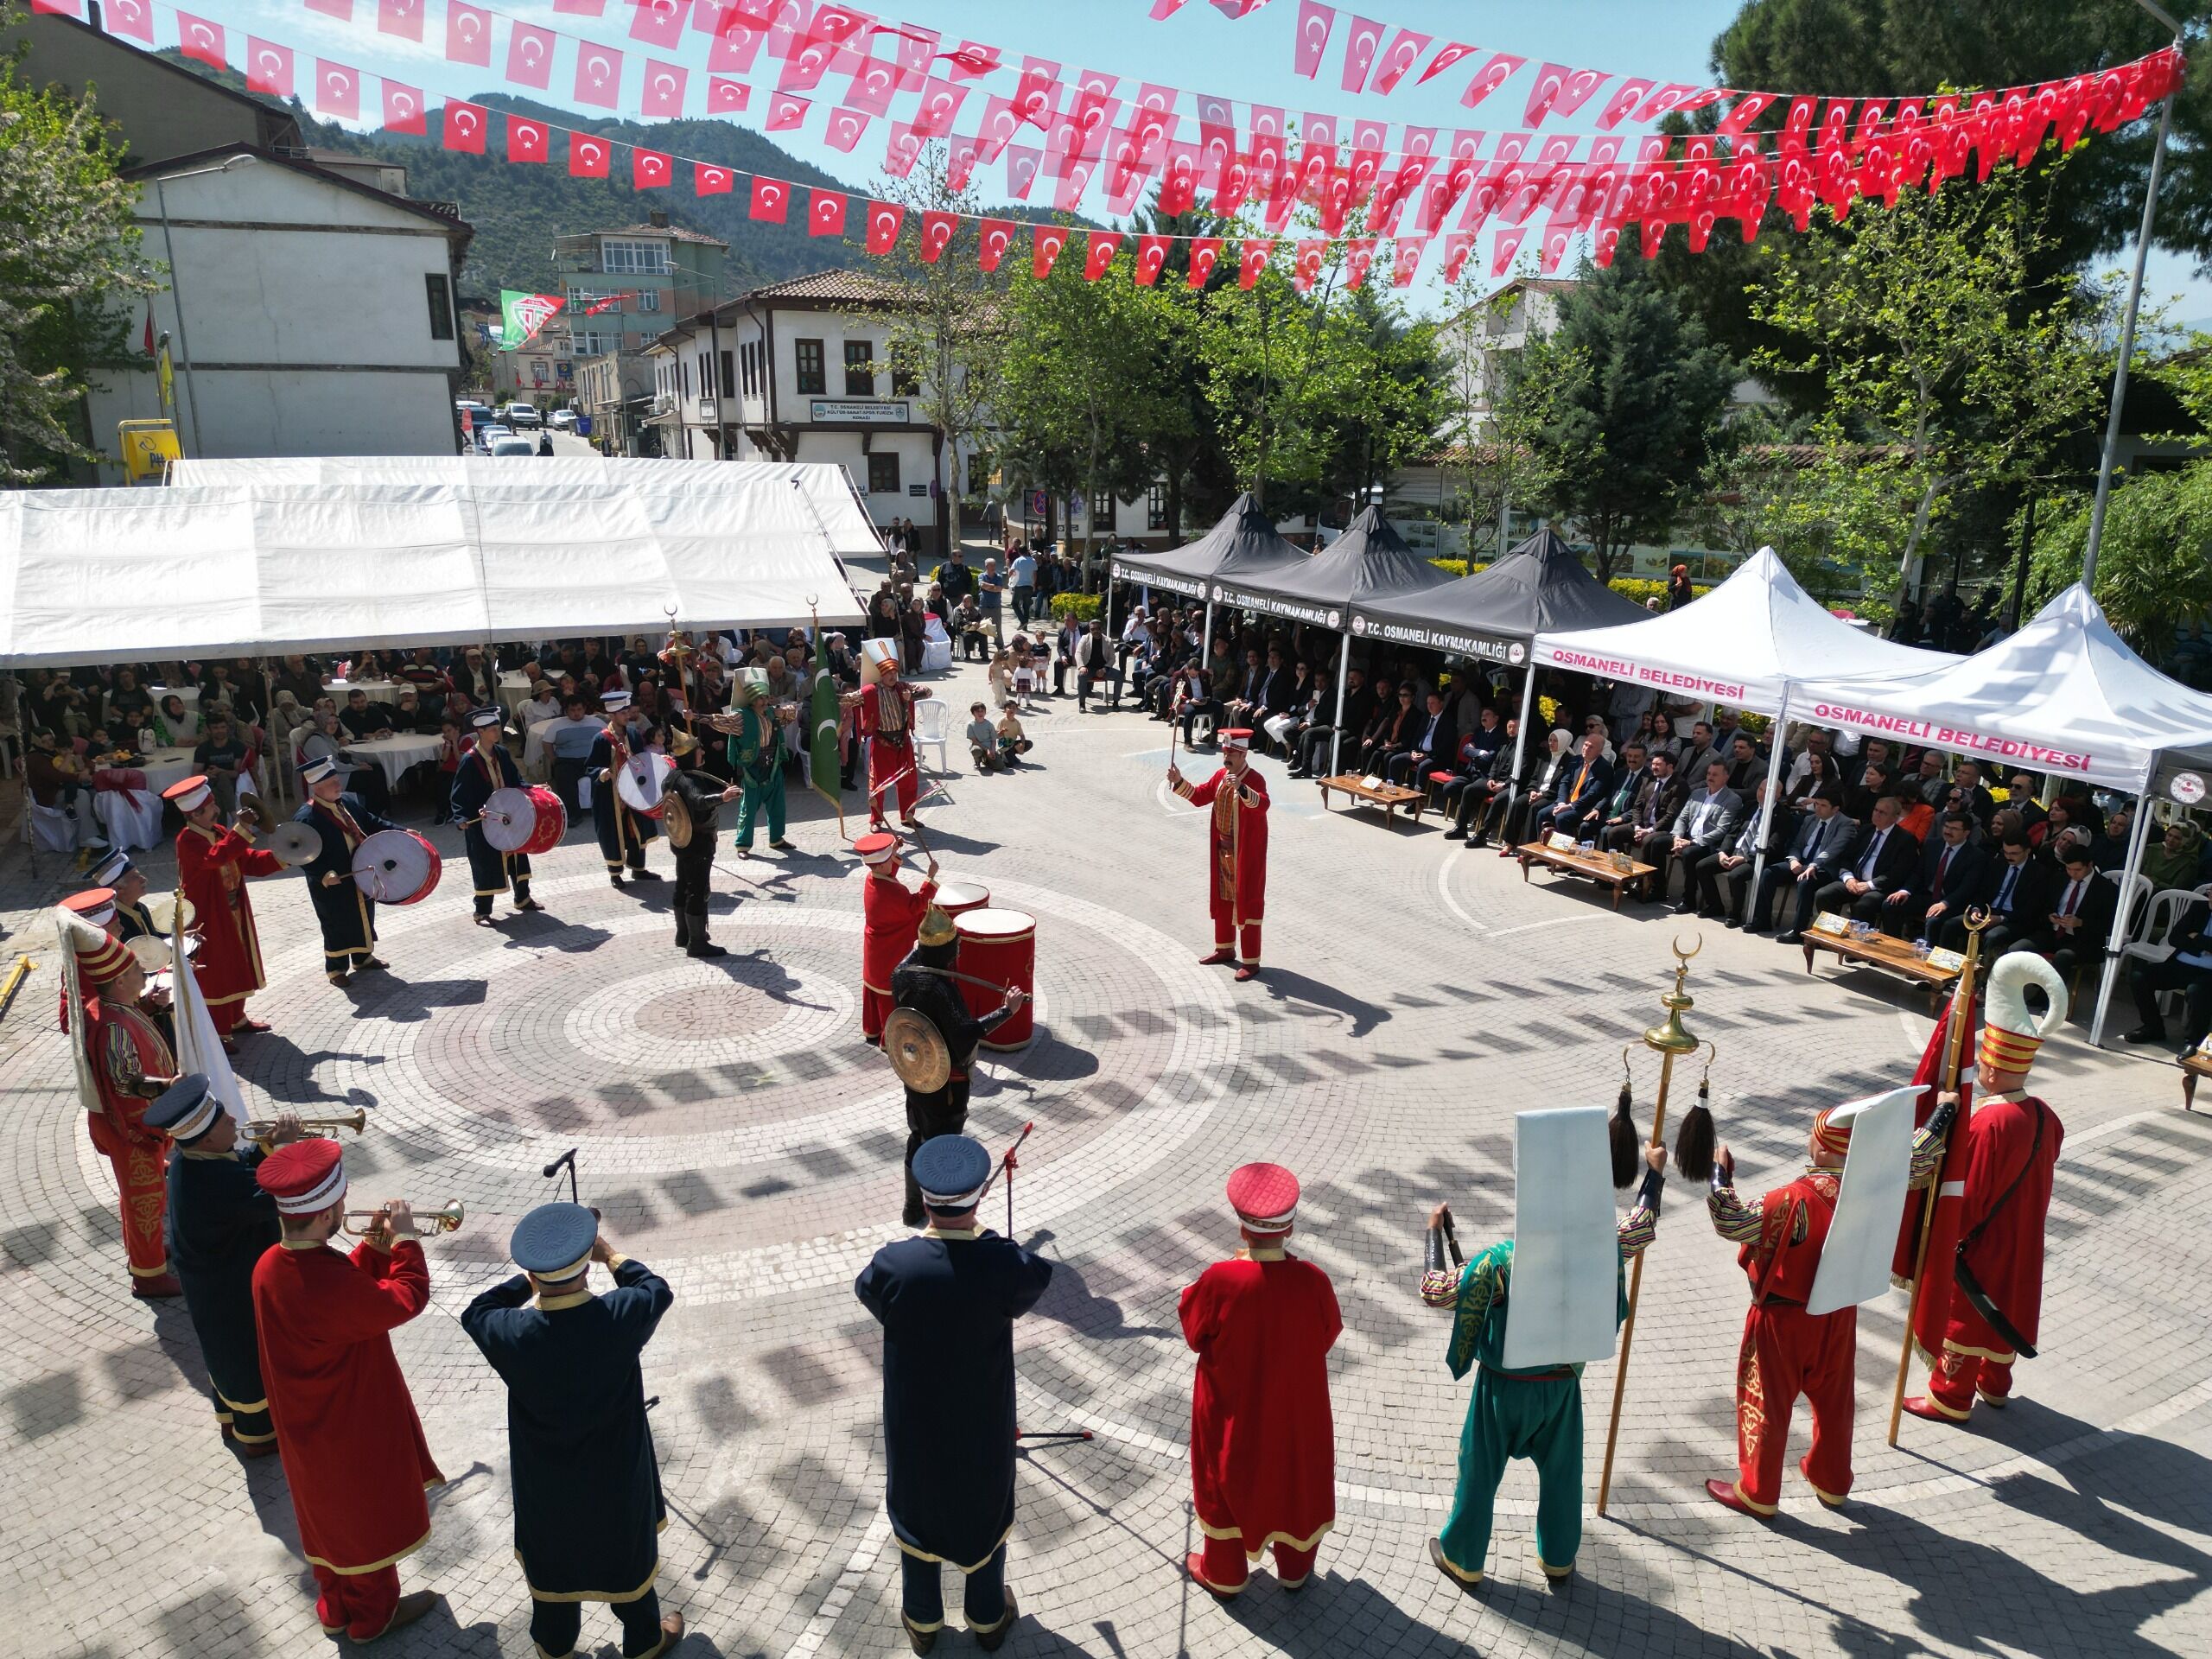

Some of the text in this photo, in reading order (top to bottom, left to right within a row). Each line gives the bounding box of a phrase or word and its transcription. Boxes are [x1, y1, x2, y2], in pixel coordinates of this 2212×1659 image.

[1122, 569, 1197, 595] T.C. OSMANELİ KAYMAKAMLIĞI
[1224, 591, 1327, 625] T.C. OSMANELİ KAYMAKAMLIĞI
[1367, 622, 1506, 659] T.C. OSMANELİ KAYMAKAMLIĞI
[1553, 650, 1745, 700] OSMANELİ BELEDİYESİ
[1815, 704, 2092, 772] OSMANELİ BELEDİYESİ
